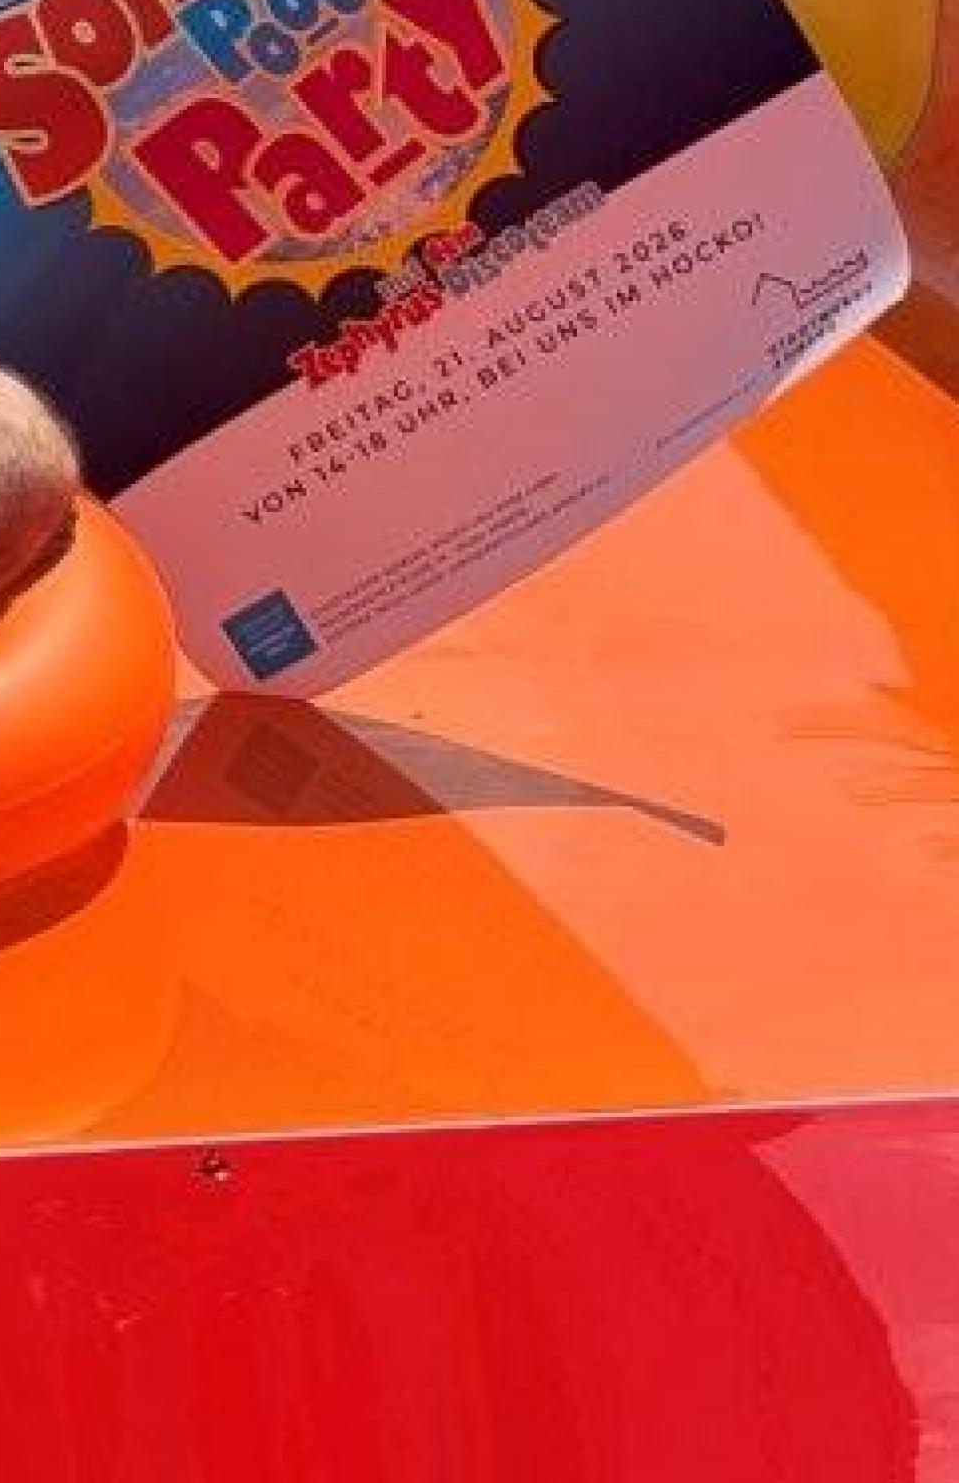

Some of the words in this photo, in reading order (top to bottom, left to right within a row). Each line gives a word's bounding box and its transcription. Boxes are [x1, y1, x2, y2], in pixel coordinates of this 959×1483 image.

[241, 479, 308, 522] VON
[476, 350, 526, 390] BEI
[537, 307, 598, 354] UNS
[604, 283, 641, 315] IM
[647, 212, 765, 290] HOCKO!
[290, 380, 427, 461] FREITAG,
[488, 267, 602, 350] AUGUST
